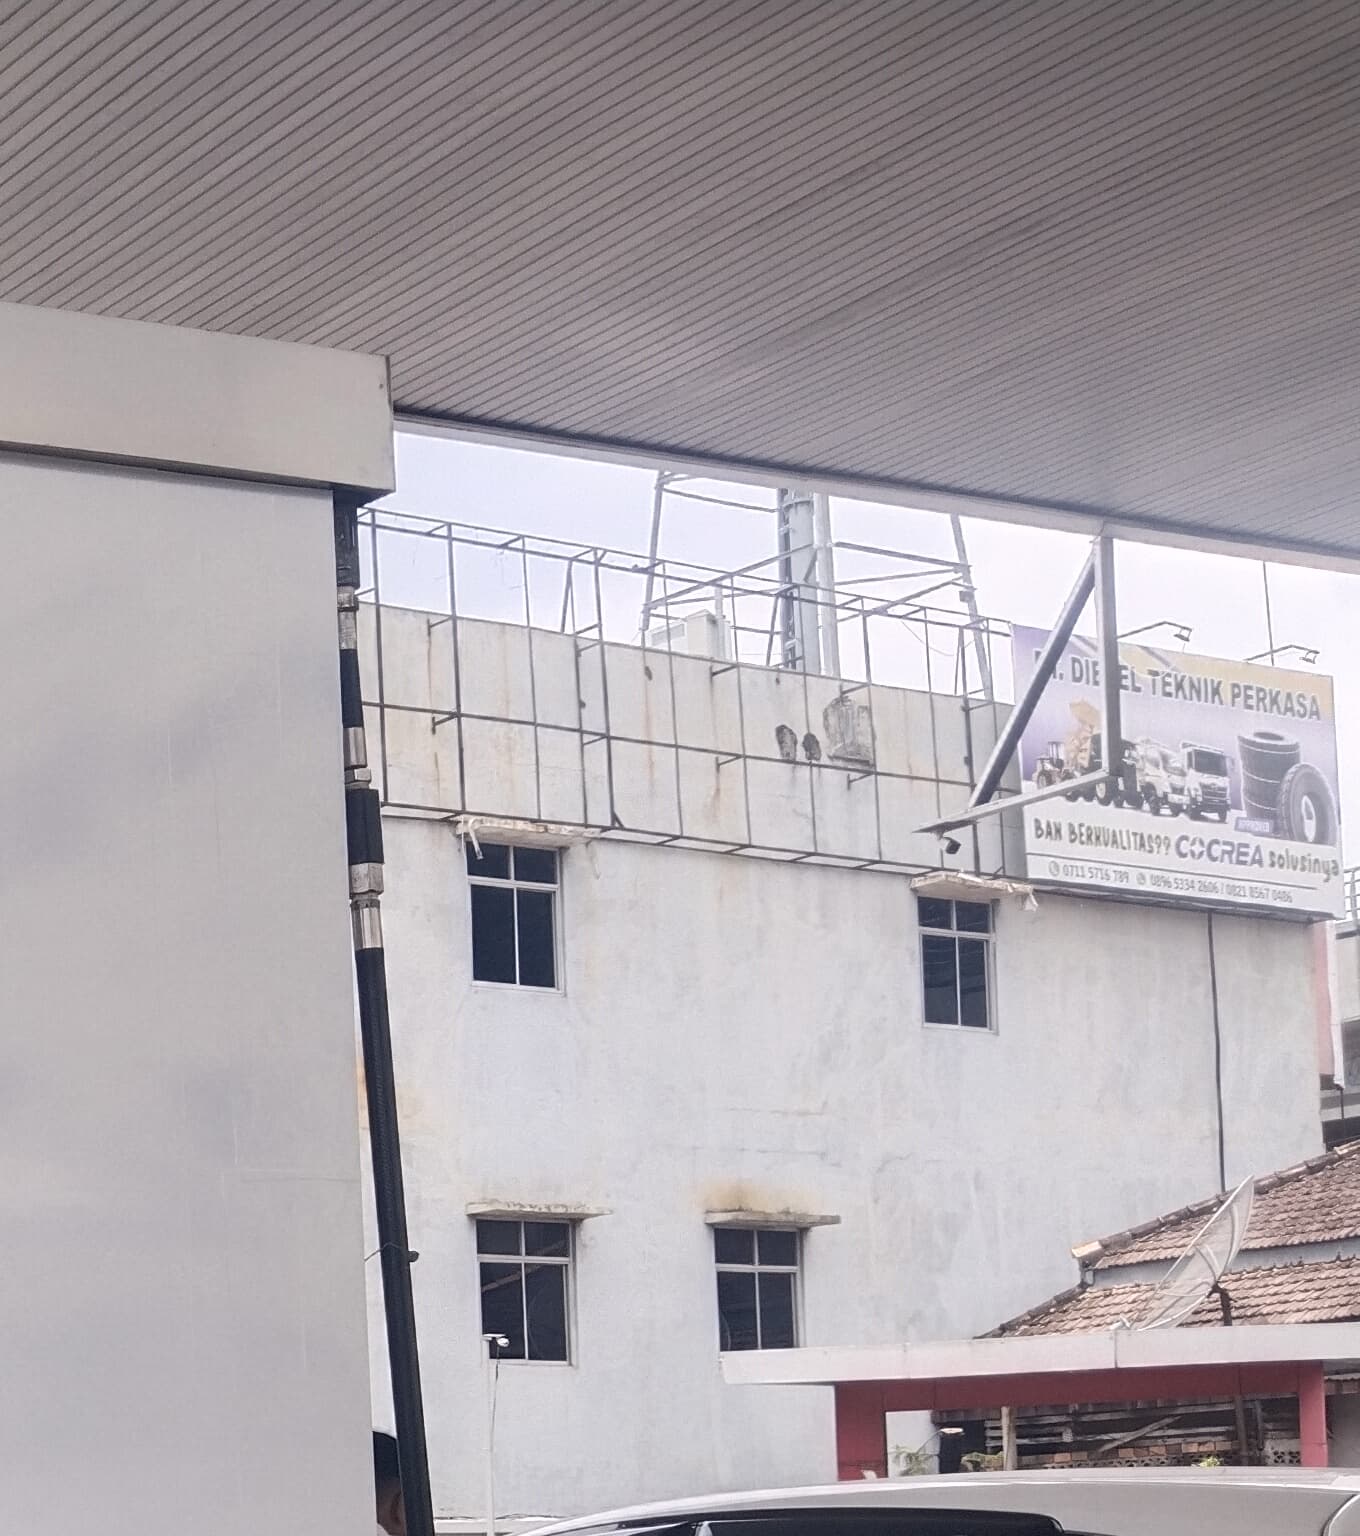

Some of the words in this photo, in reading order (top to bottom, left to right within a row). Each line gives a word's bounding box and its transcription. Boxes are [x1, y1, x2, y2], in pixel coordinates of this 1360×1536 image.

[1071, 656, 1142, 693] DIEEL
[1147, 668, 1225, 707] TEKNIK
[1231, 682, 1321, 721] PERKASA
[1175, 834, 1265, 868] COCREA
[1268, 848, 1340, 883] solusinya
